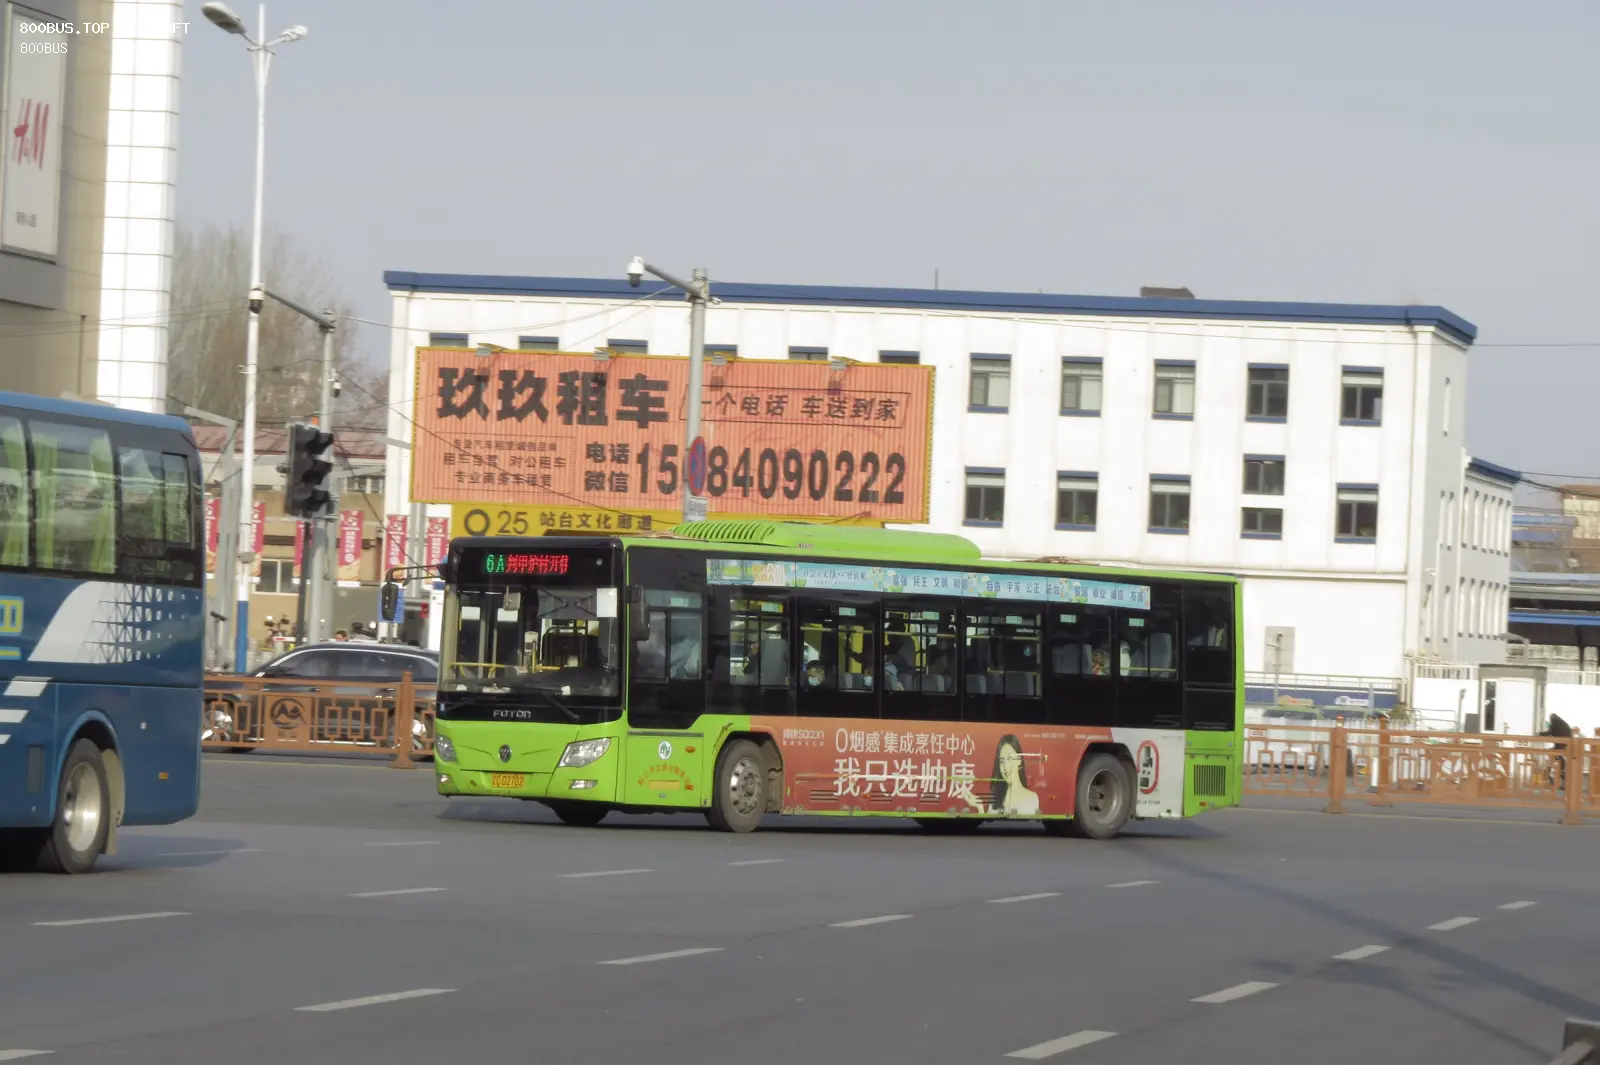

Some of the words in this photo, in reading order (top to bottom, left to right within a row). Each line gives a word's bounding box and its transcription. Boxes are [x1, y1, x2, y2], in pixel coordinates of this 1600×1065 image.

[436, 367, 669, 429] 玖玖租车
[800, 394, 899, 421] 车送到家
[585, 441, 630, 465] 电话
[584, 469, 629, 493] 微信
[637, 442, 906, 504] 1584090222
[497, 511, 529, 534] 25
[486, 554, 504, 573] 6A
[913, 576, 928, 588] 民主
[933, 577, 948, 588] 文明
[986, 581, 1000, 592] 自由
[1006, 581, 1020, 593] 平等
[1026, 582, 1040, 594] 公正
[833, 756, 976, 799] 我只选帅康
